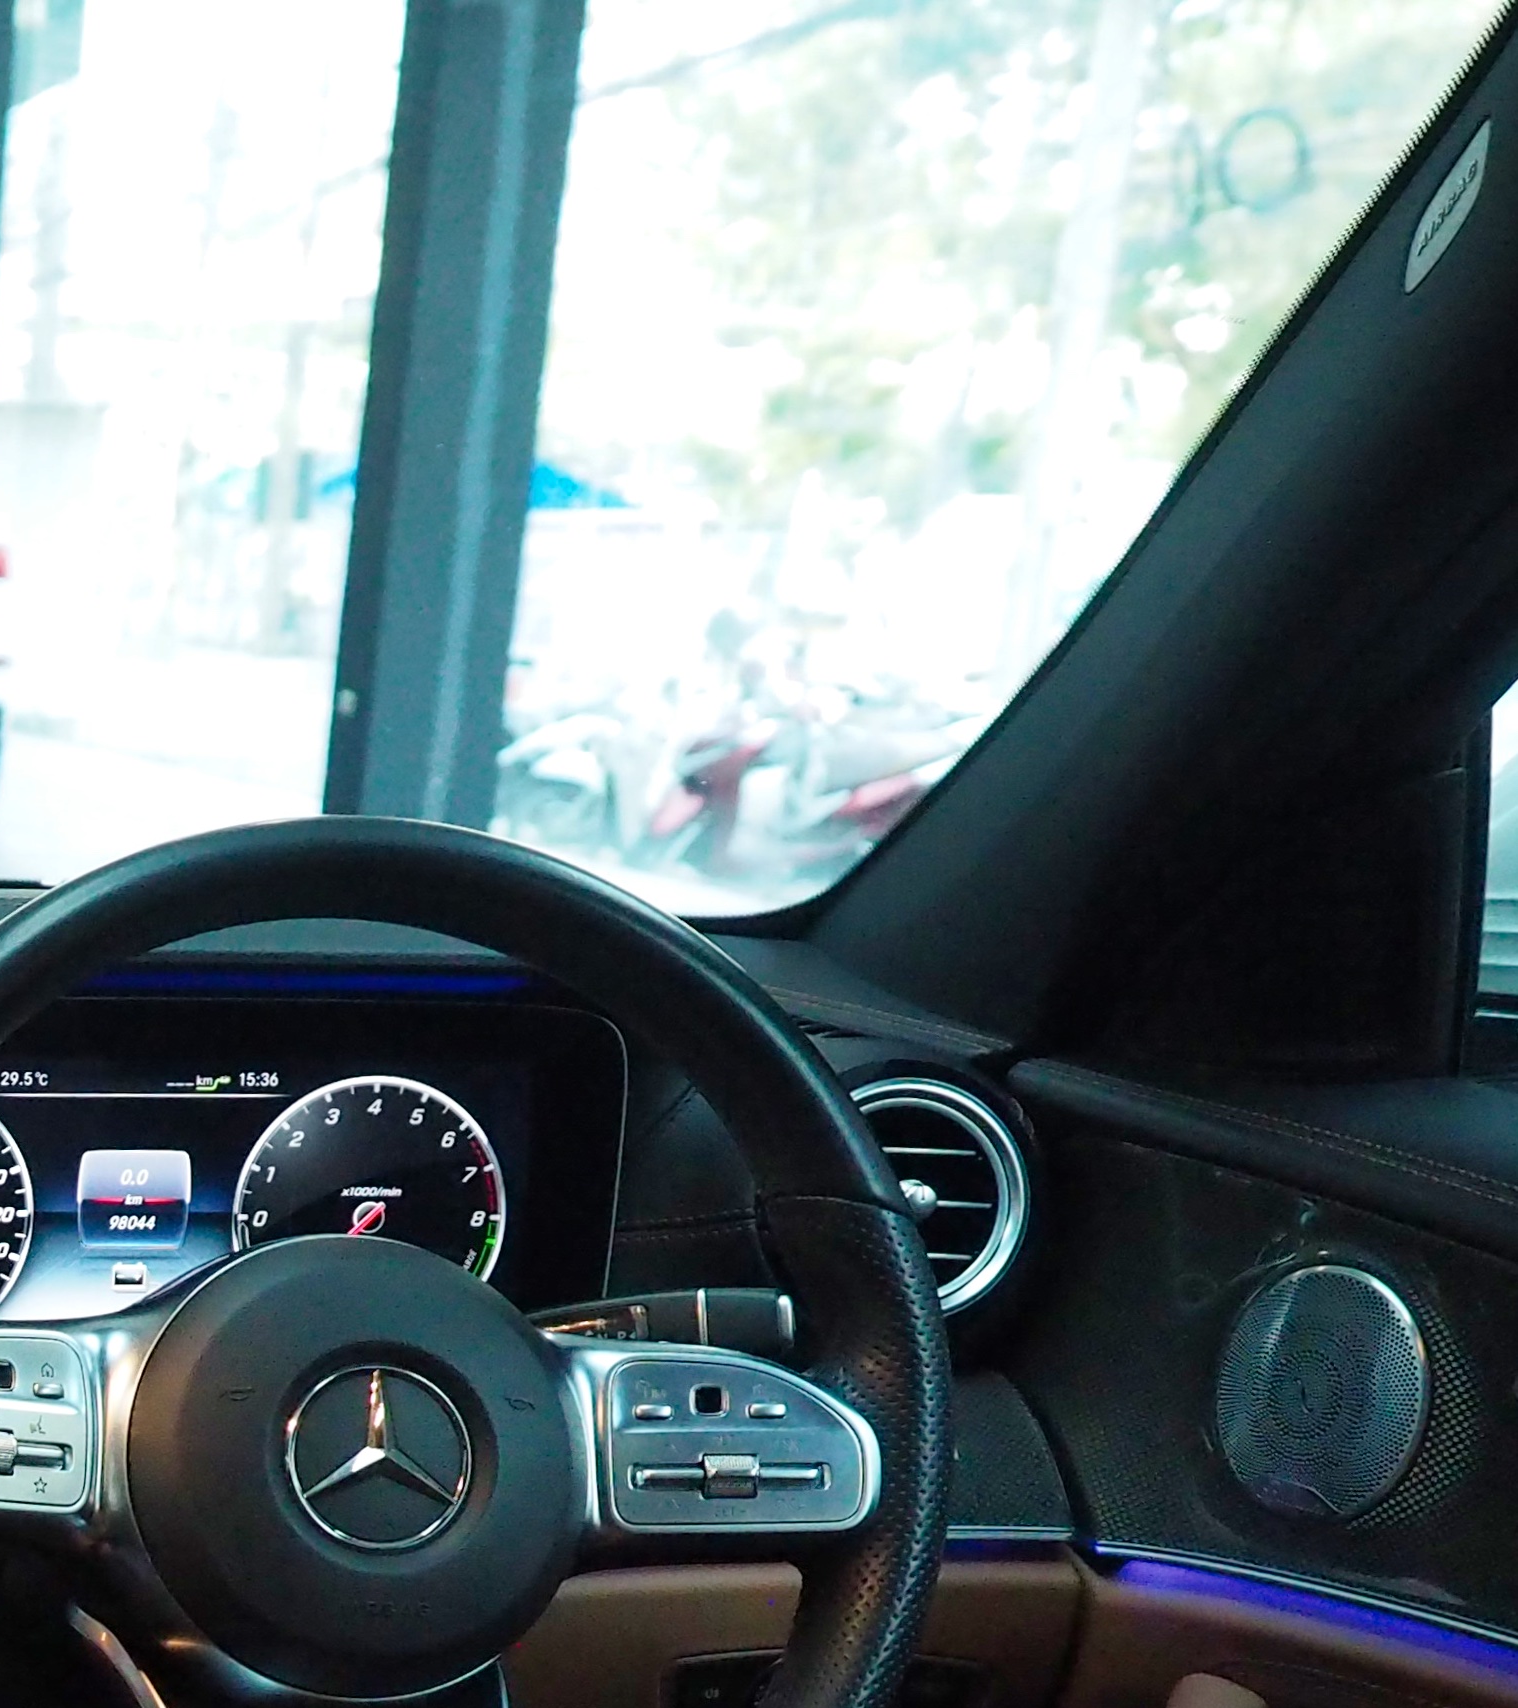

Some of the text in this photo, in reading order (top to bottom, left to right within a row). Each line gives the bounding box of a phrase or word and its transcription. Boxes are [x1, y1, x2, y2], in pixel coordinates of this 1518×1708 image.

[1417, 159, 1479, 257] AIRBAG
[195, 1074, 214, 1087] km
[238, 1071, 280, 1088] 15:36
[366, 1098, 383, 1116] 4
[324, 1107, 341, 1126] 3
[408, 1107, 426, 1126] 5
[288, 1130, 305, 1148] 2
[440, 1130, 457, 1148] 6
[119, 1168, 150, 1186] 0.0
[265, 1165, 276, 1184] 1
[461, 1165, 478, 1184] 7
[123, 1193, 144, 1207] km
[340, 1186, 404, 1198] x1000/min
[108, 1213, 157, 1232] 98044
[252, 1210, 269, 1229] 0
[469, 1209, 487, 1228] 8
